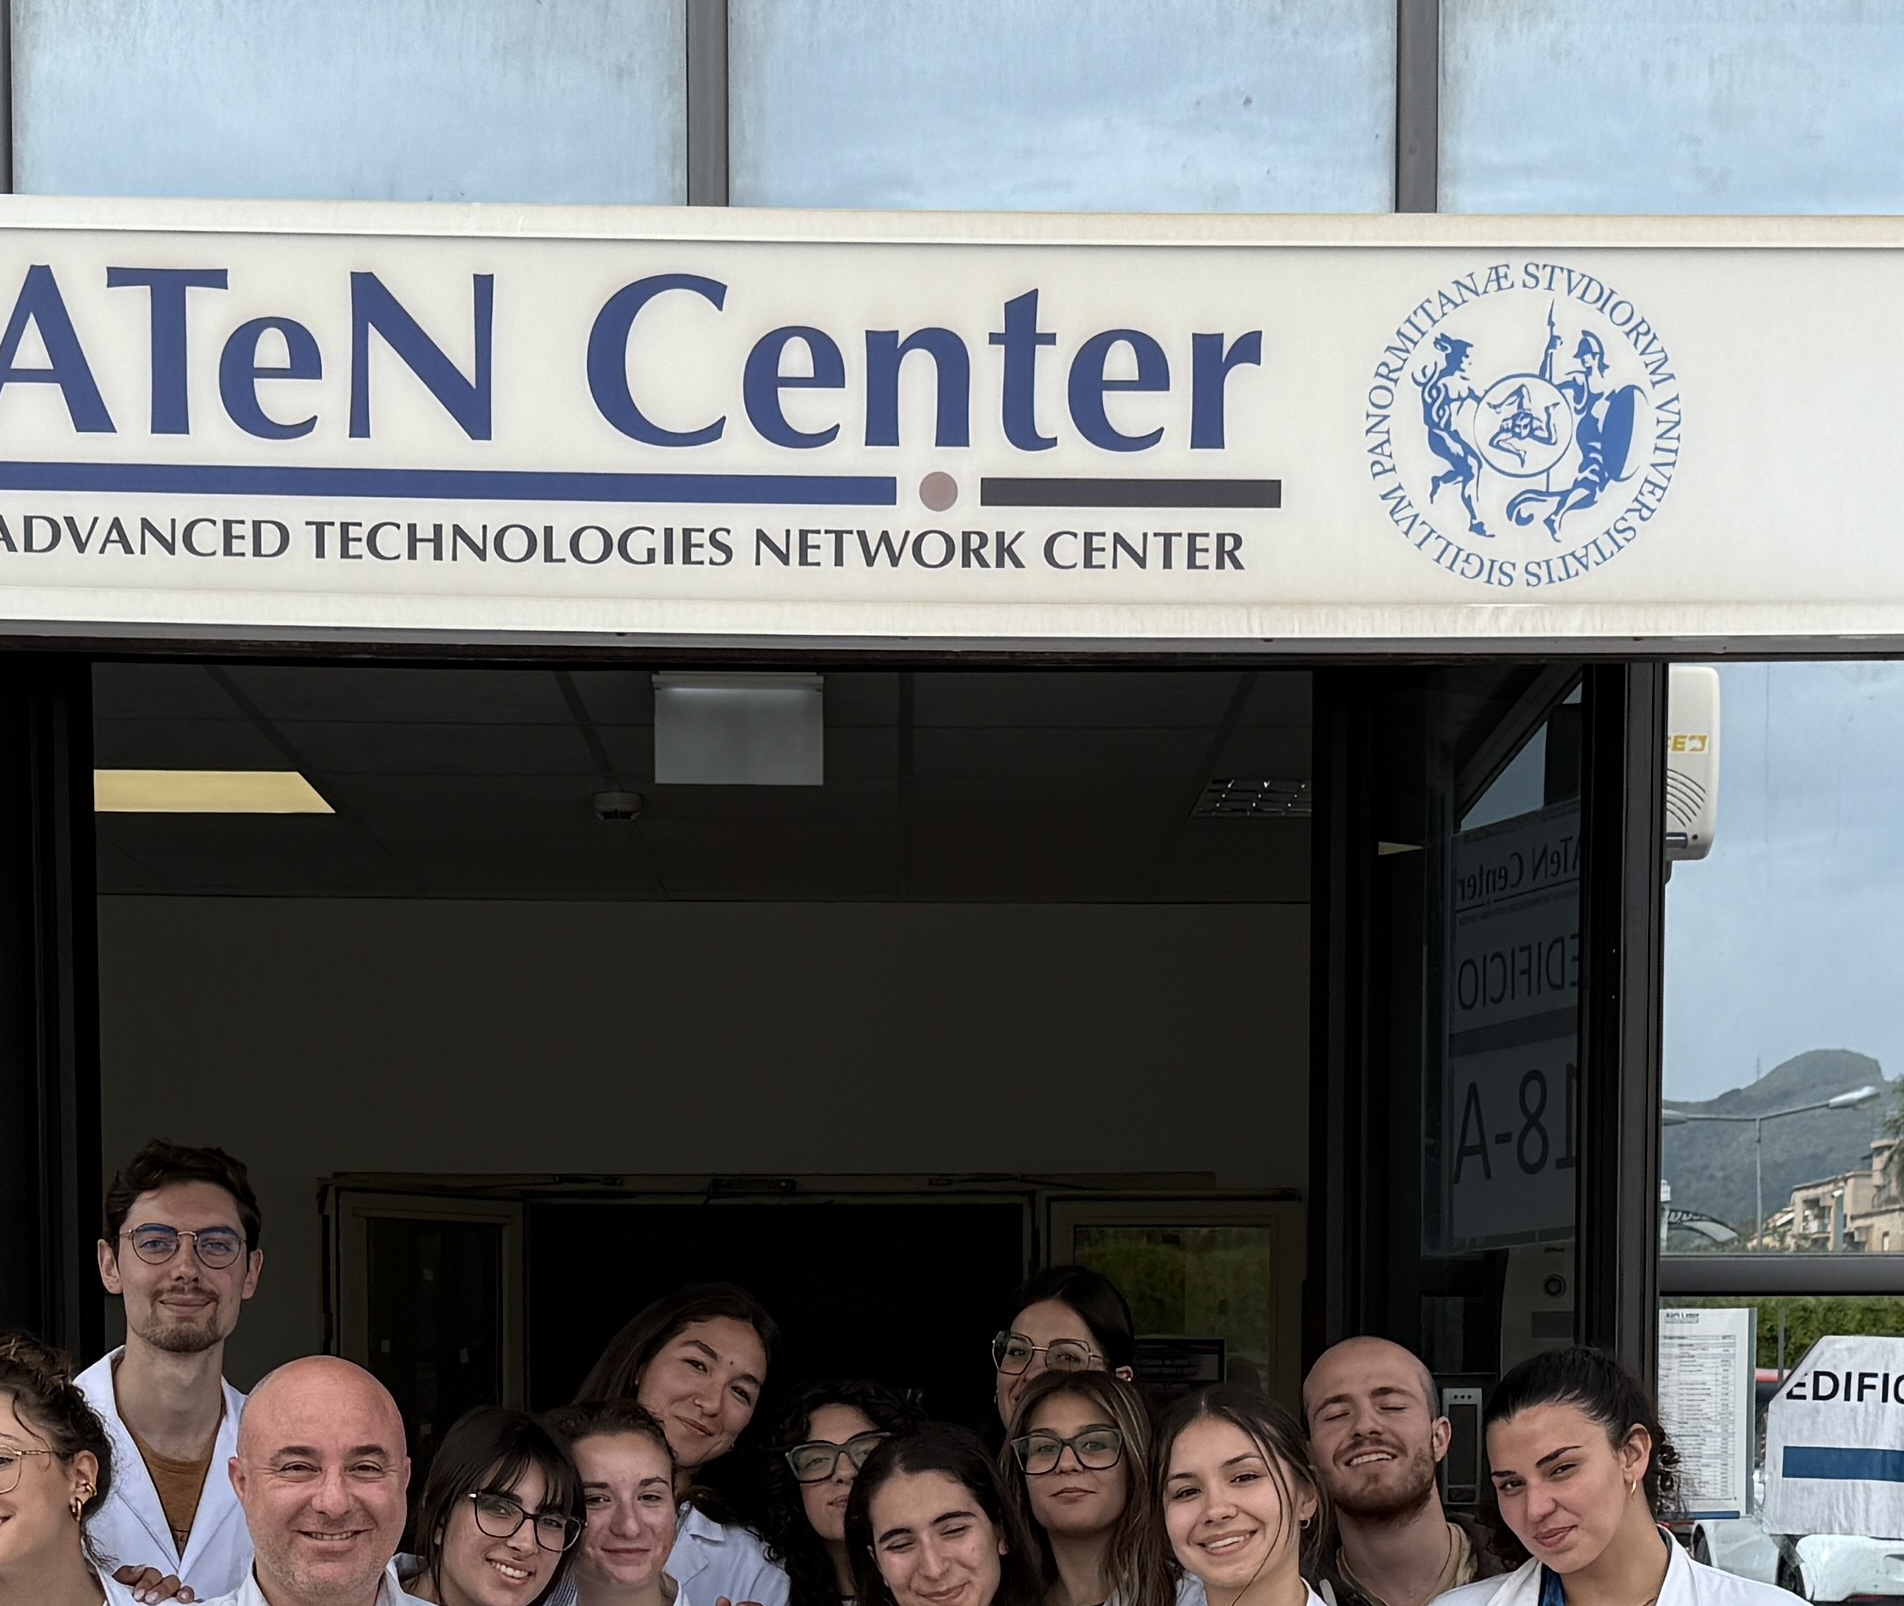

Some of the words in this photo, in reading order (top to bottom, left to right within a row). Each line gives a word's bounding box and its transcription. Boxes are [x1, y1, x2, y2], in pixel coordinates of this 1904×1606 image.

[586, 272, 1263, 453] Center
[1364, 264, 1514, 481] PANORMITANÆ
[1523, 262, 1677, 390] STVDIORVM
[304, 520, 733, 566] TECHNOLOGIES
[754, 527, 1027, 570] NETWORK
[1043, 529, 1245, 571] CENTER
[1379, 485, 1515, 588] SIGILLVM
[1525, 393, 1682, 588] VNIVERSITATIS
